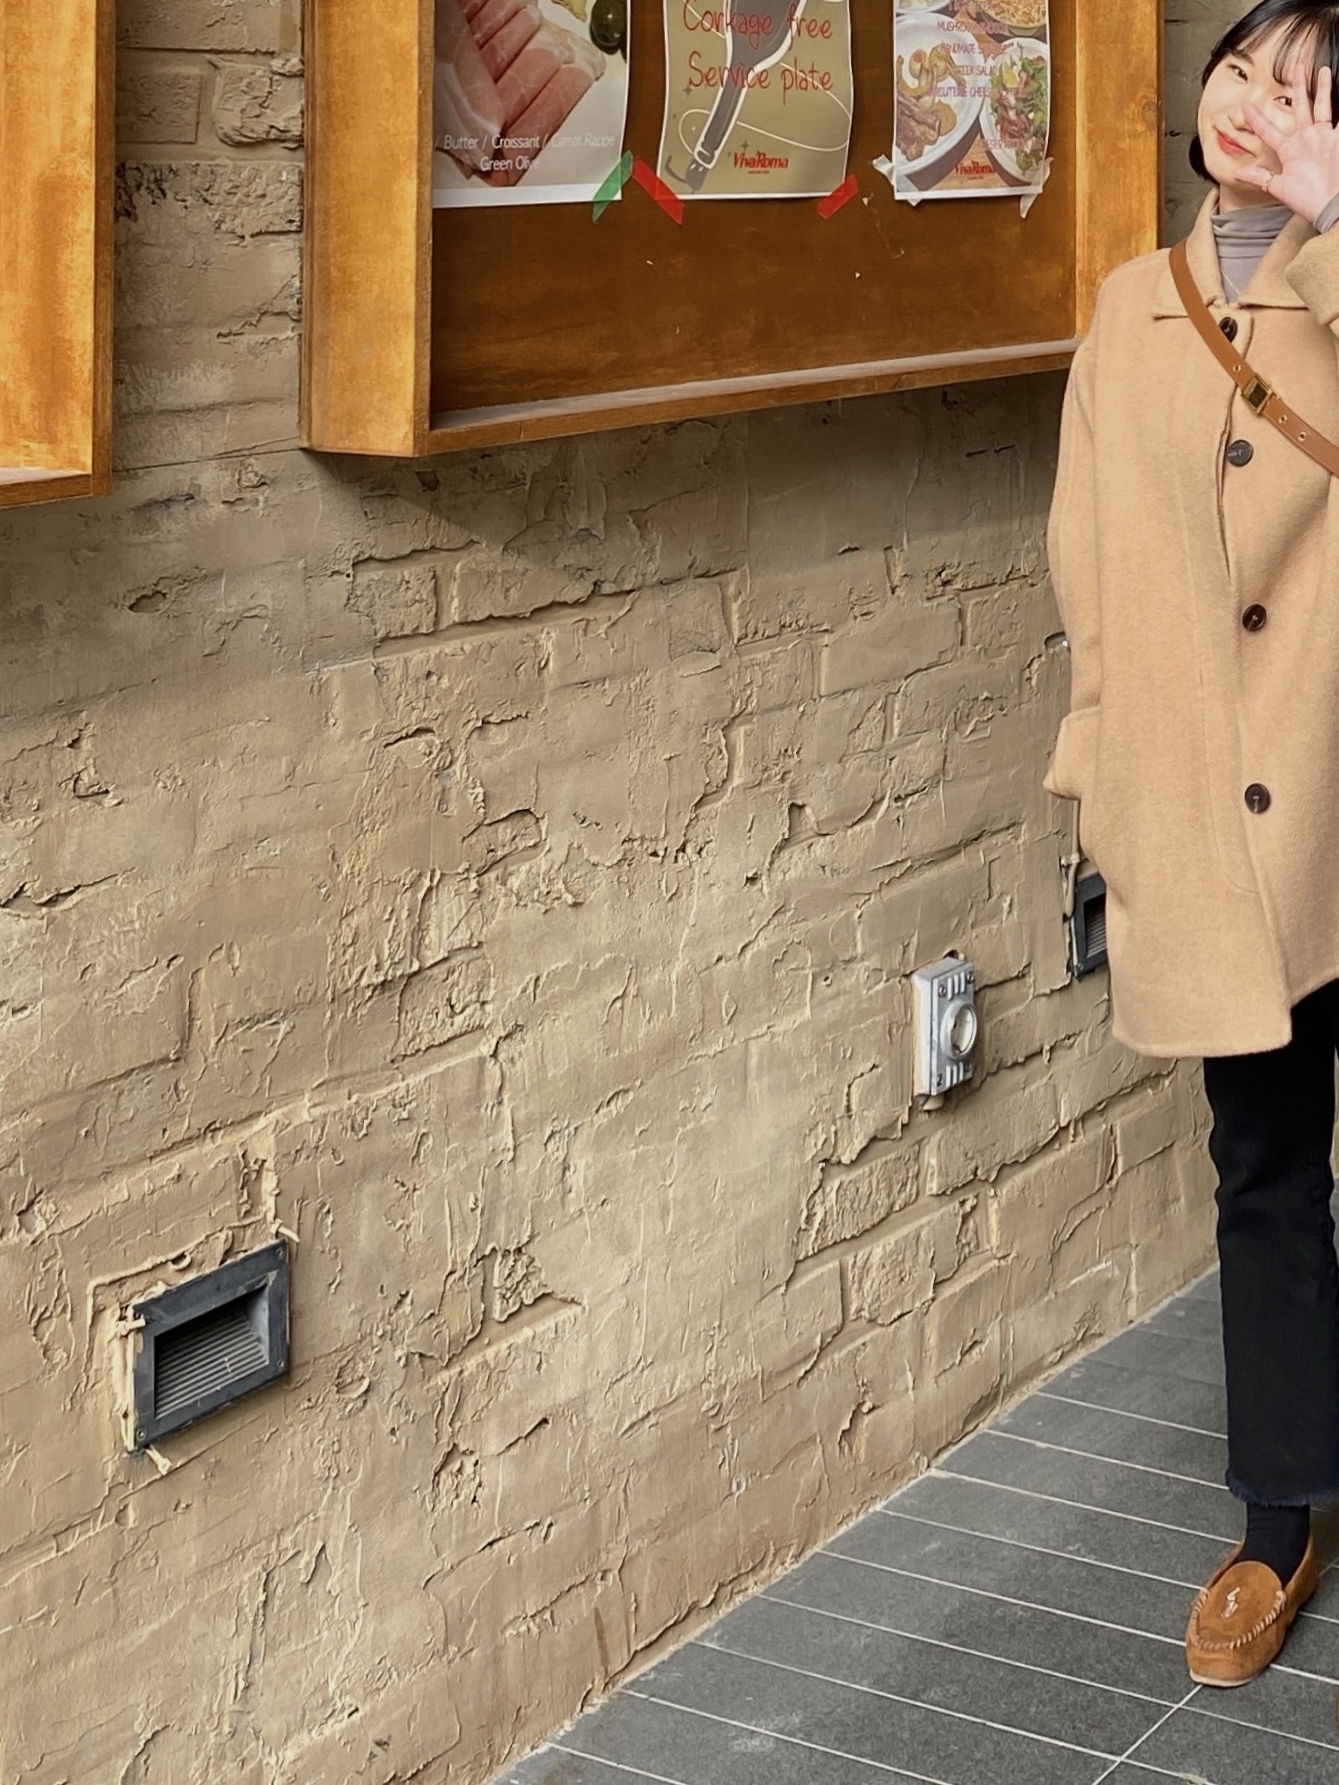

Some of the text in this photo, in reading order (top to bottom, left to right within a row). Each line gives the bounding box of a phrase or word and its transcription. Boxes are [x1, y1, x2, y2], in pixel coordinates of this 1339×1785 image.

[786, 2, 833, 51] free
[688, 50, 833, 105] Service plate
[443, 135, 479, 149] Butter
[491, 134, 540, 149] Croissant
[480, 156, 540, 171] Green Olive
